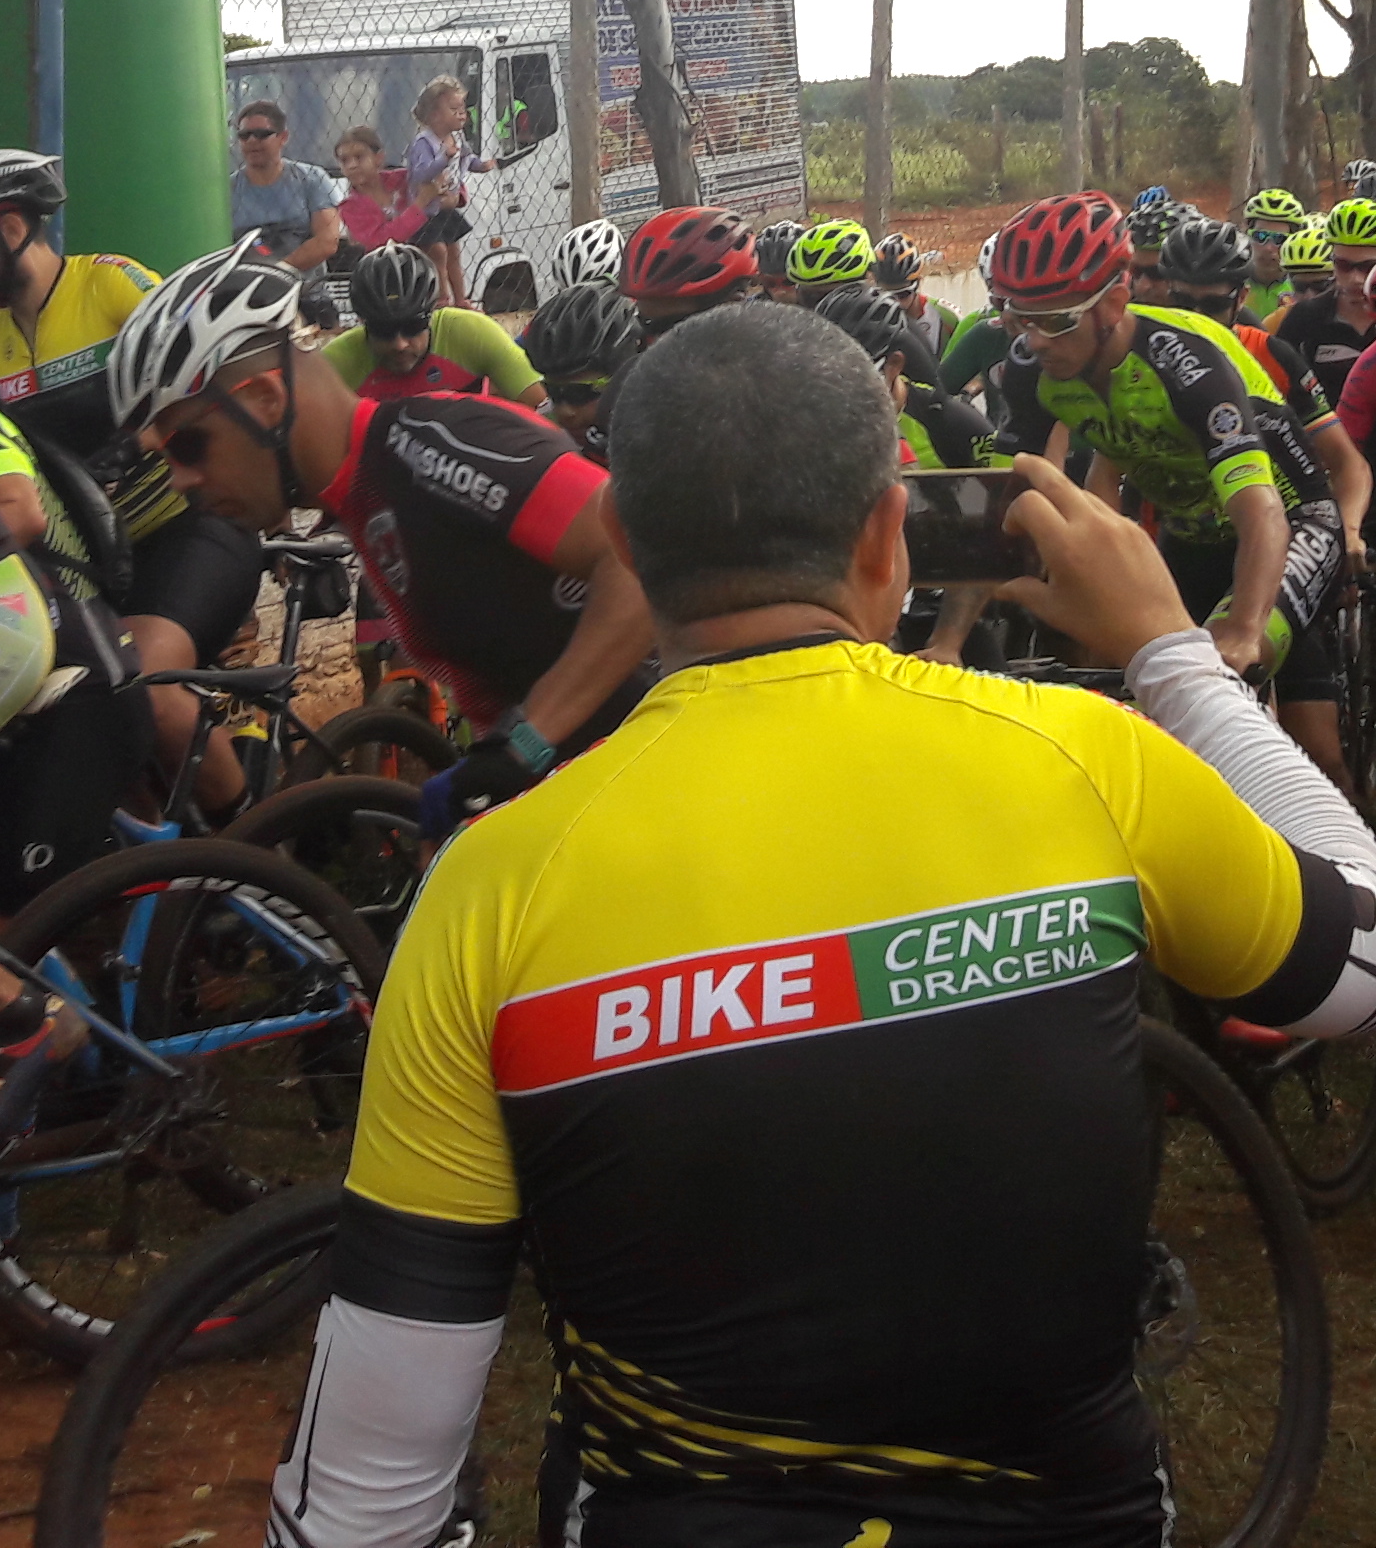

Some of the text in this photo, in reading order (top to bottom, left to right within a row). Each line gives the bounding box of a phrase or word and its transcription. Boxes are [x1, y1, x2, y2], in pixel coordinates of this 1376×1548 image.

[42, 349, 97, 378] CENTER
[884, 896, 1091, 973] CENTER
[593, 953, 814, 1061] BIKE
[887, 940, 1098, 1008] DRACENA
